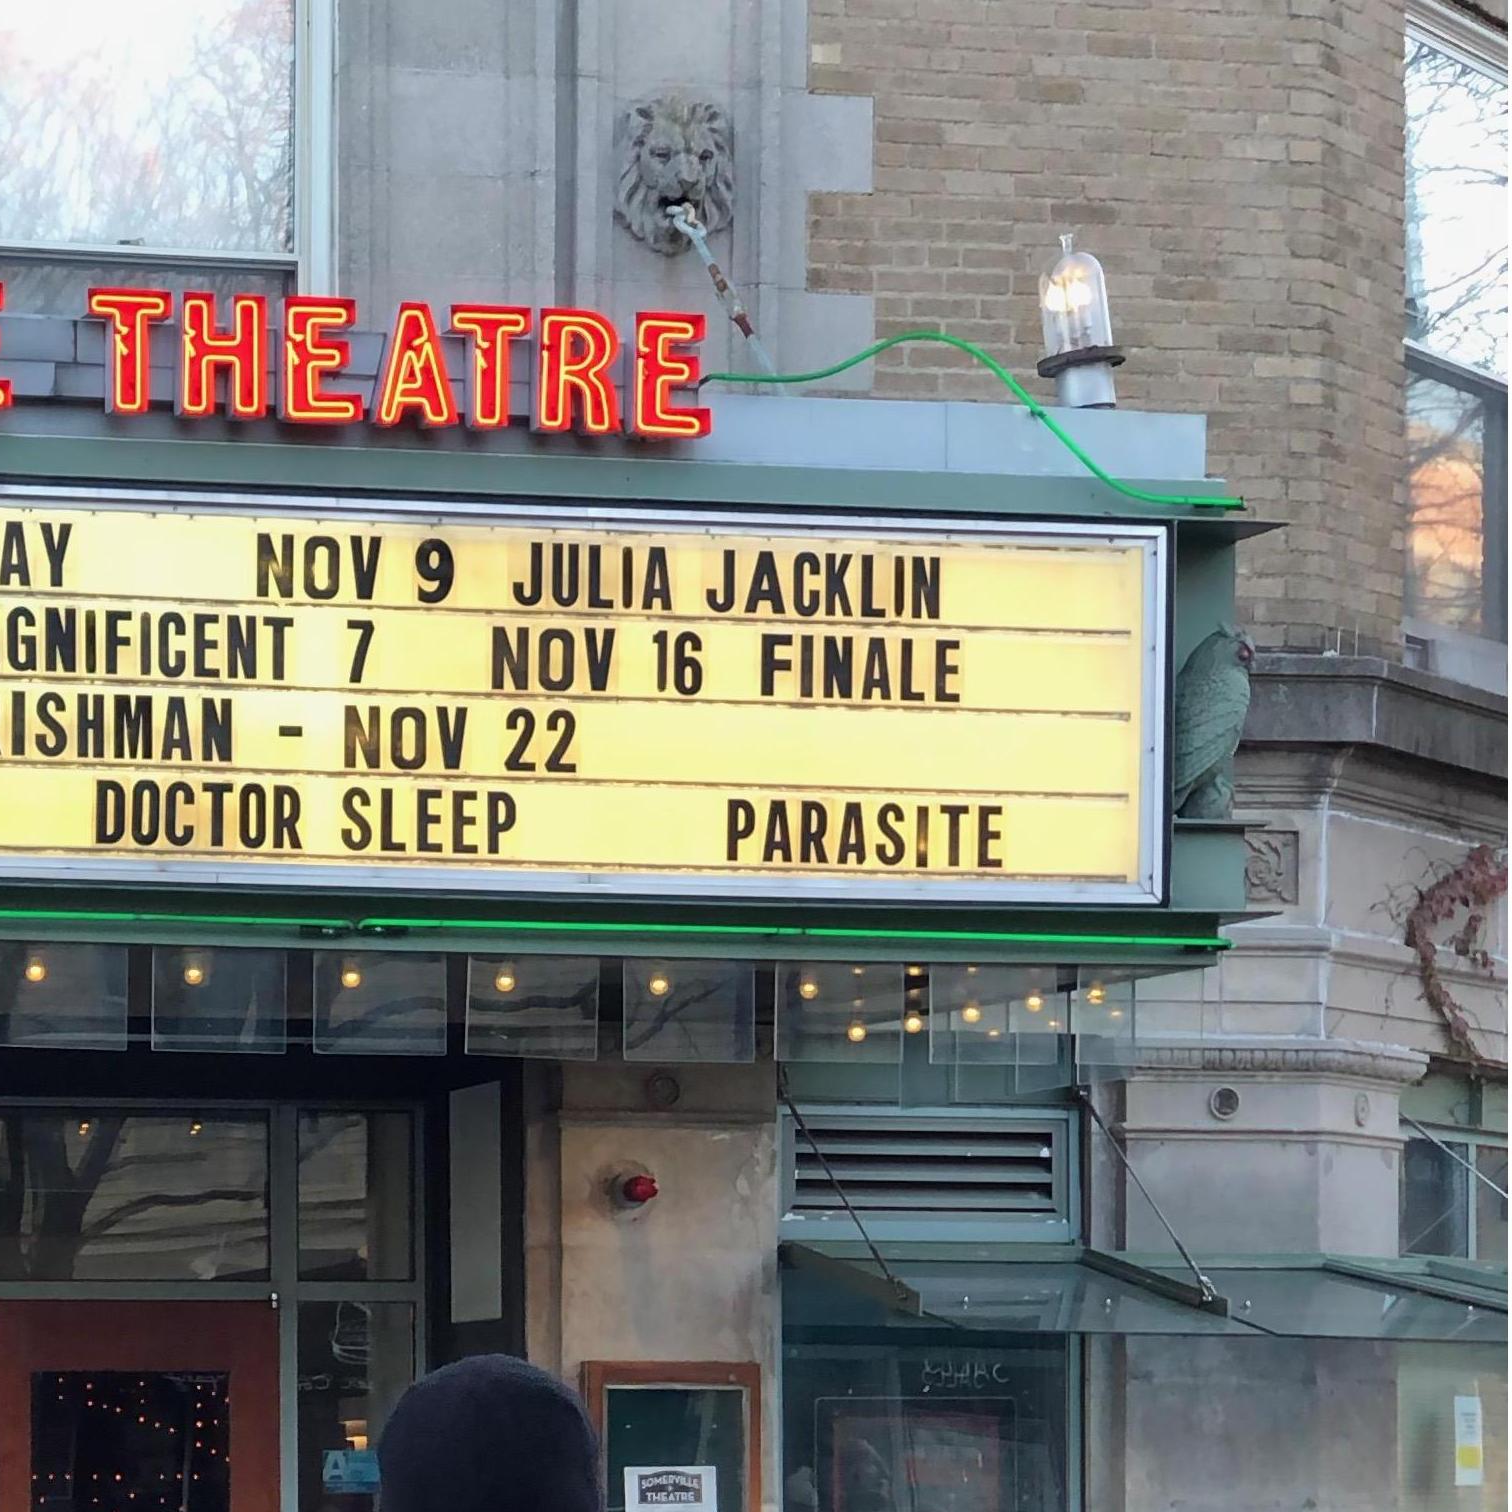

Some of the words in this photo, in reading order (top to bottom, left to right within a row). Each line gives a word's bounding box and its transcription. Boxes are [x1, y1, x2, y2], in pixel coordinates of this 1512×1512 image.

[89, 287, 712, 440] THEATRE
[257, 534, 381, 599] NOV
[416, 539, 454, 603] 9
[514, 543, 671, 610] JULIA
[707, 550, 939, 618] JACKLIN
[348, 621, 374, 682] 7
[493, 627, 614, 691] NOV
[654, 631, 702, 695] 16
[762, 634, 959, 702] FINALE
[346, 706, 467, 769] NOV
[505, 709, 575, 772] 22
[96, 781, 301, 850] DOCTOR
[342, 788, 515, 853] SLEEP
[728, 800, 1001, 867] PARASITE
[641, 1474, 699, 1489] SOMERVILLE
[645, 1491, 695, 1502] THEATRE
